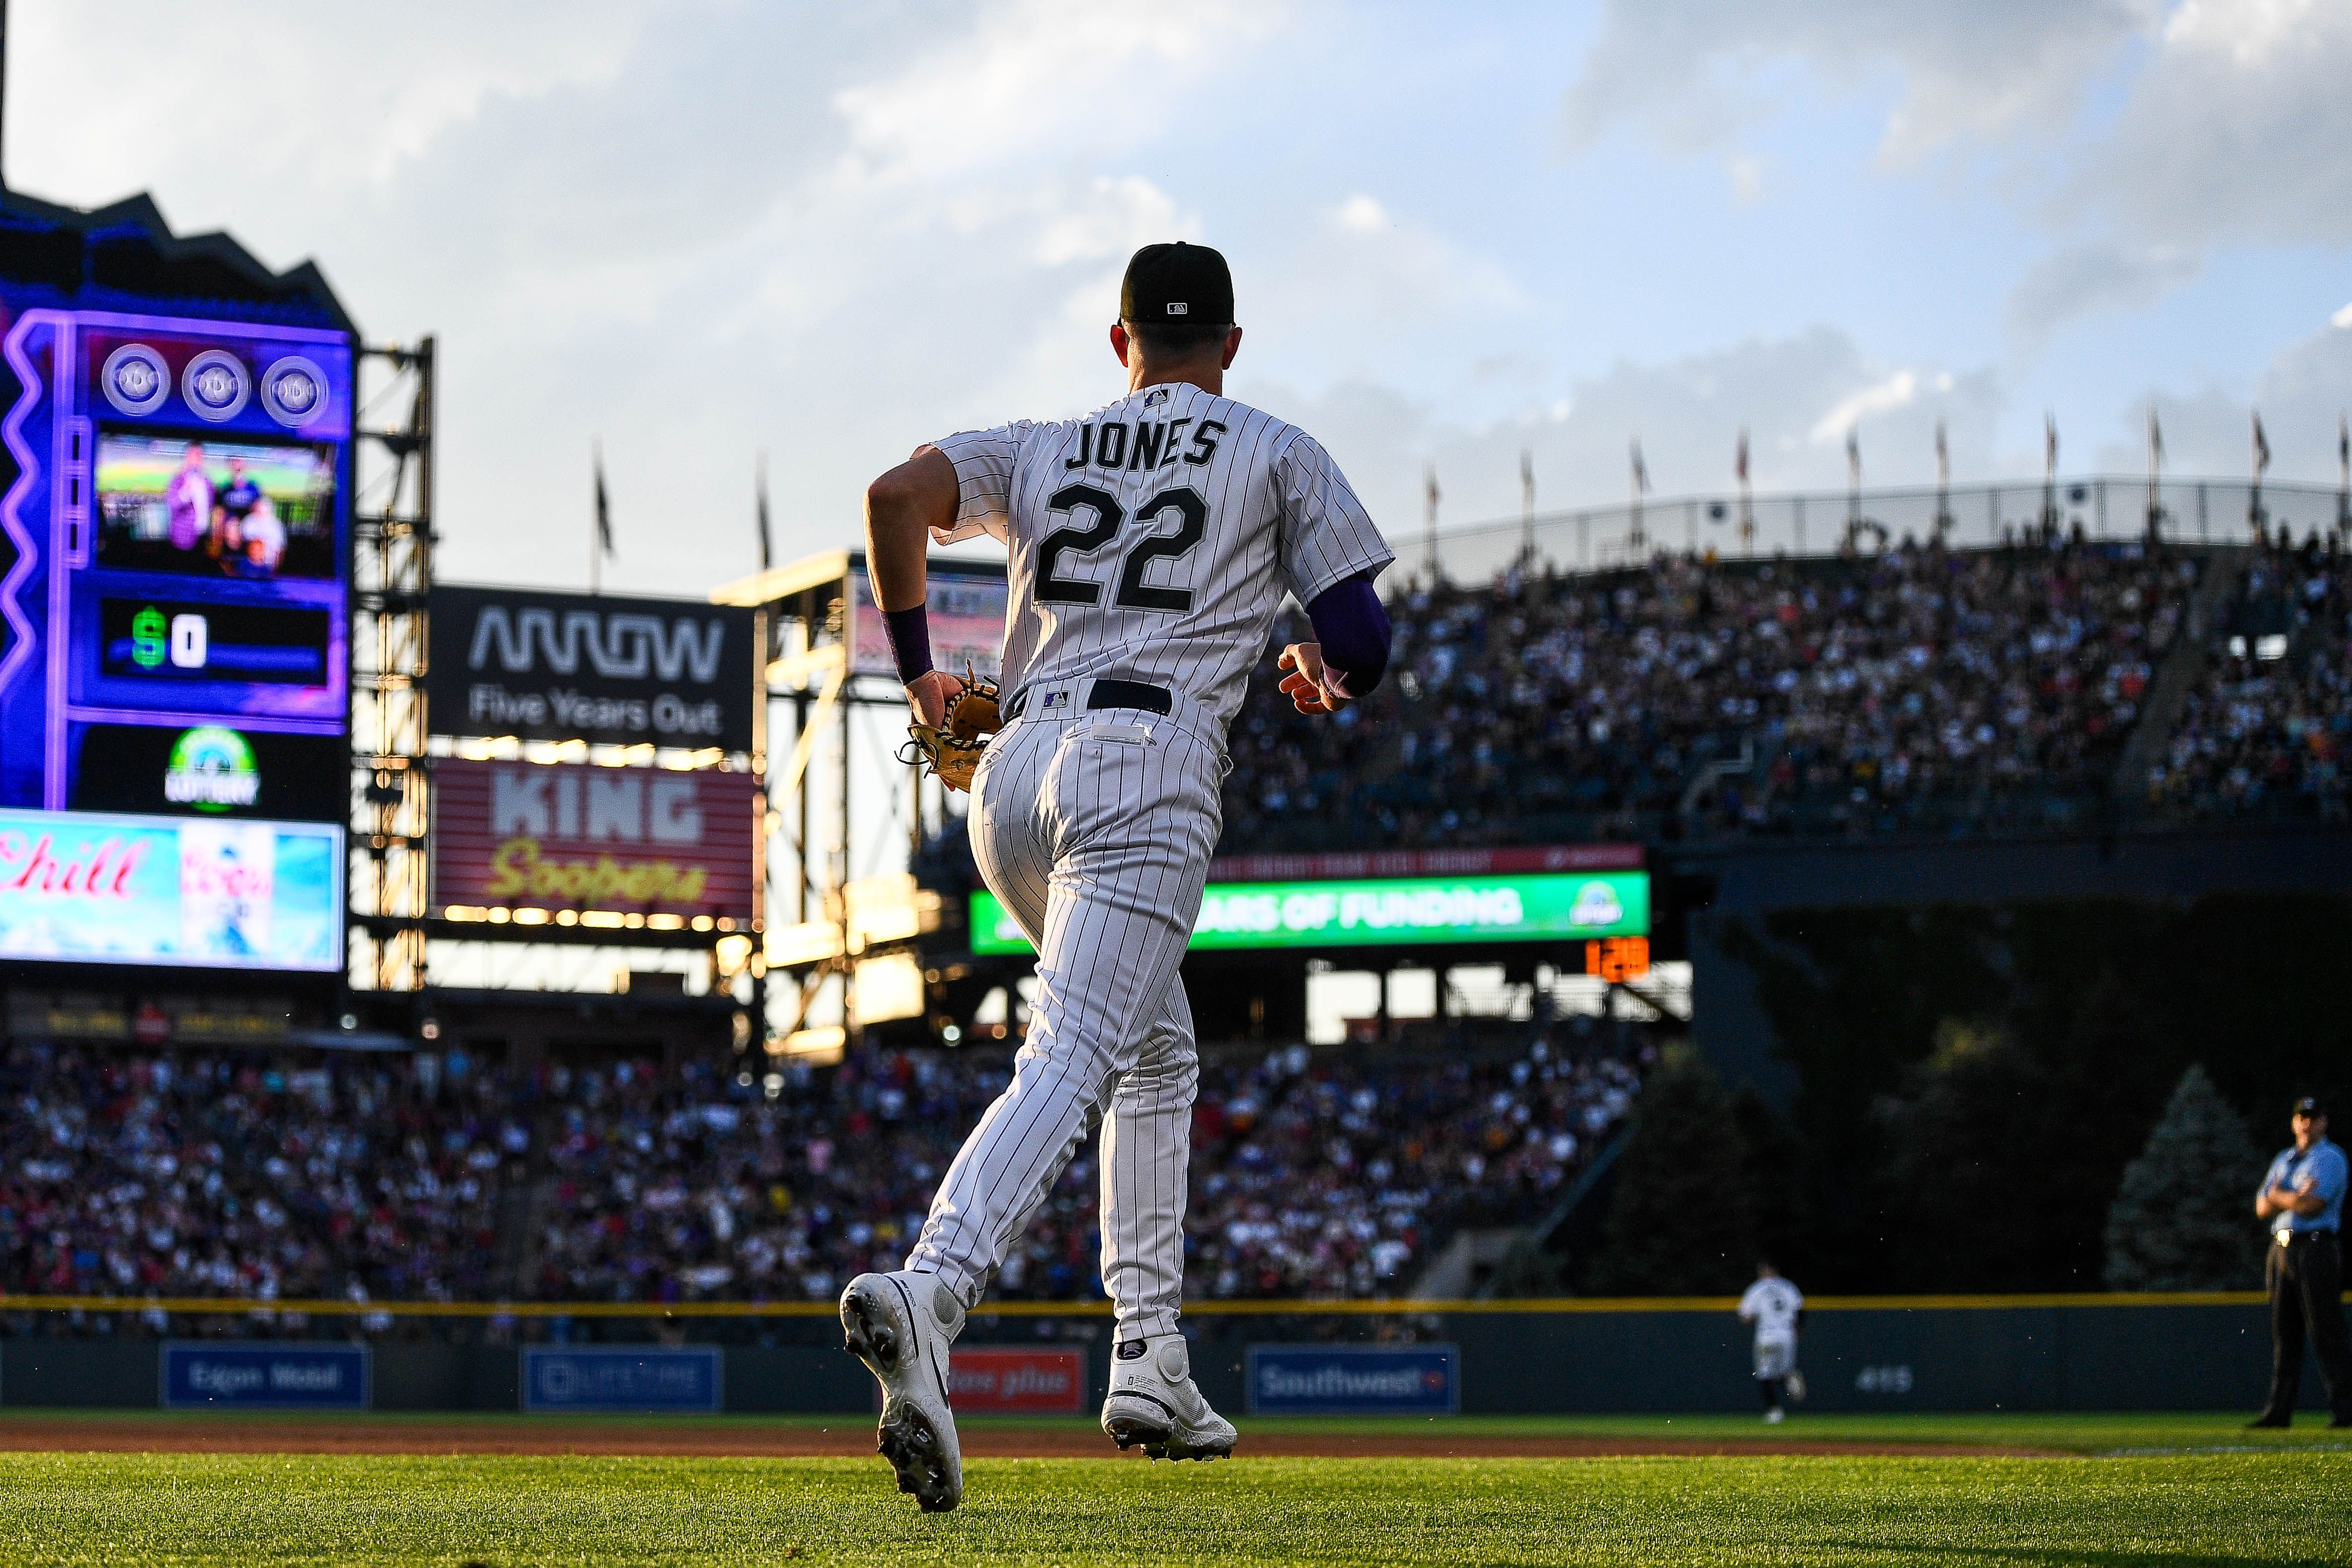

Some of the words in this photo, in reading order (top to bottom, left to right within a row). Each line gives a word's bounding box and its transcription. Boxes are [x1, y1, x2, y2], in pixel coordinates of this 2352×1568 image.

[1064, 416, 1228, 473] JONES
[1033, 481, 1210, 615] 22
[468, 604, 726, 683] ARROW
[469, 683, 547, 725] Five
[550, 687, 648, 729] Years
[651, 693, 723, 735] Out
[489, 770, 704, 845] KING
[1194, 896, 1279, 931] ARS
[1281, 894, 1337, 930] OF
[1340, 889, 1522, 926] FUNDING
[1261, 1364, 1422, 1397] Southwest
